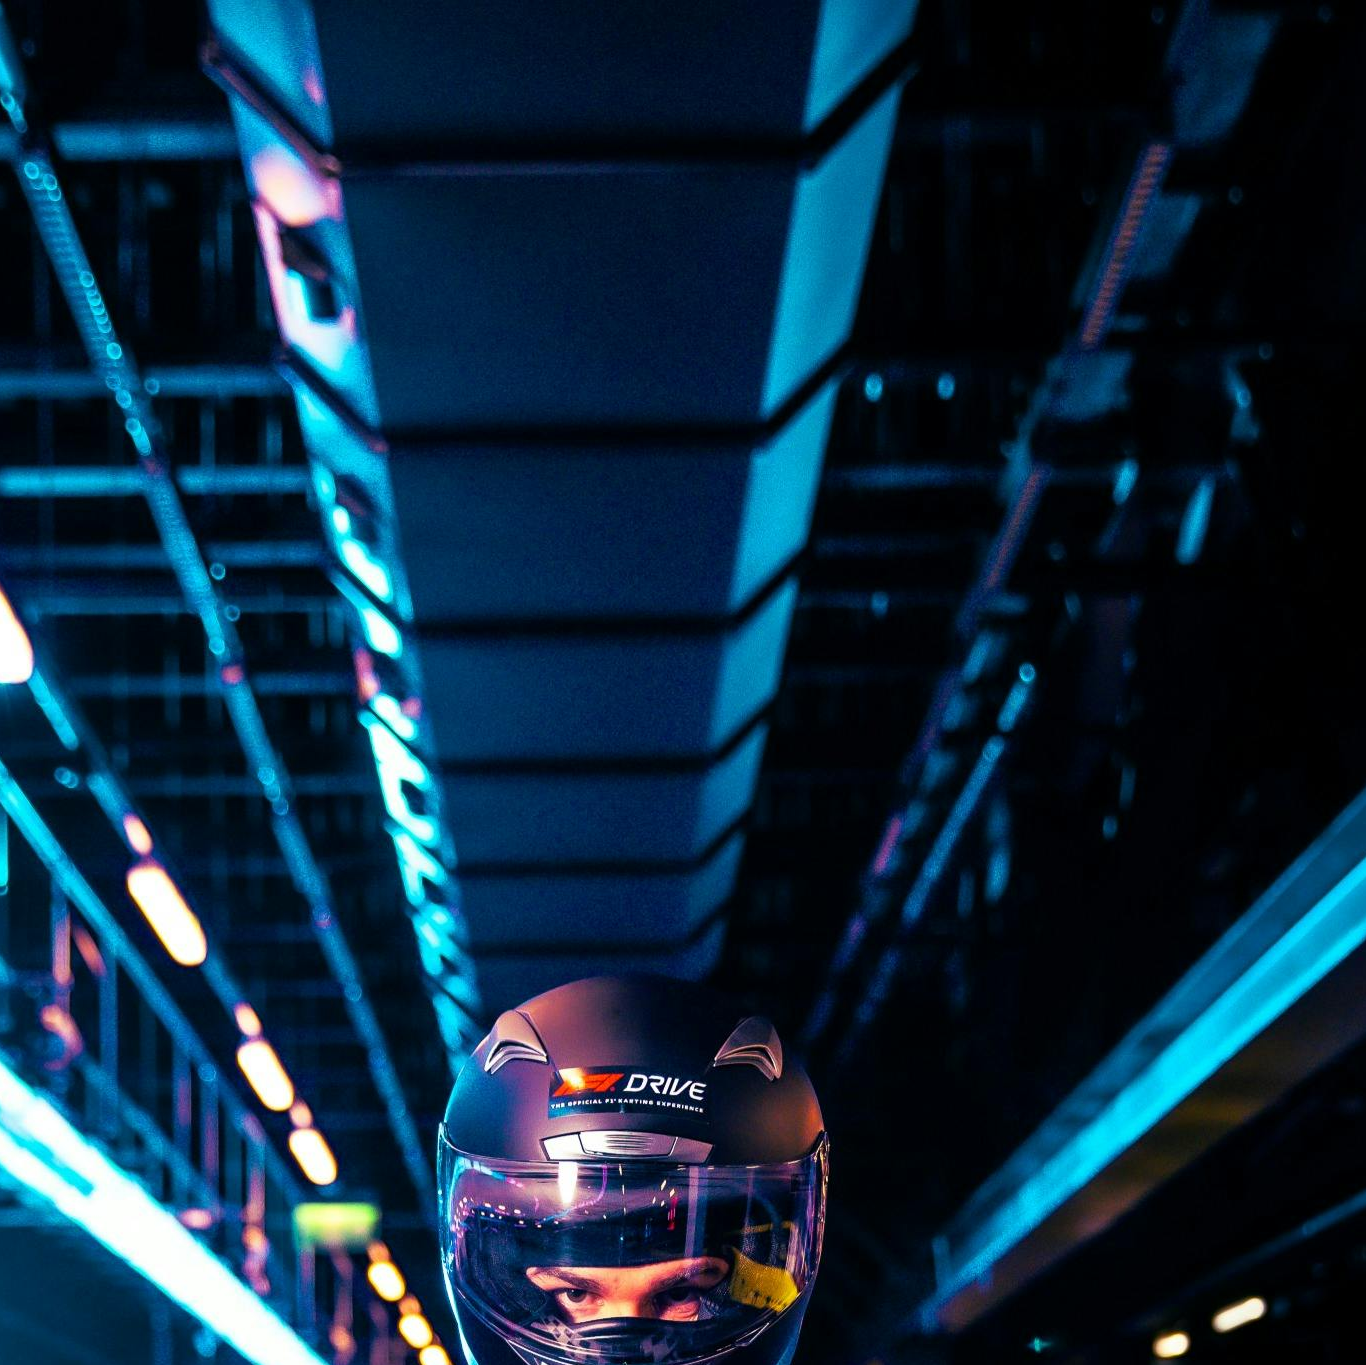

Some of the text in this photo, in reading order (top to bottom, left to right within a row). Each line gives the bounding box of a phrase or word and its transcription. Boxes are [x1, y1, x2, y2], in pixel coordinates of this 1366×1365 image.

[623, 1073, 707, 1101] DRIVE
[567, 1099, 602, 1107] OFFICIAL
[657, 1101, 704, 1113] EXPERIENCE
